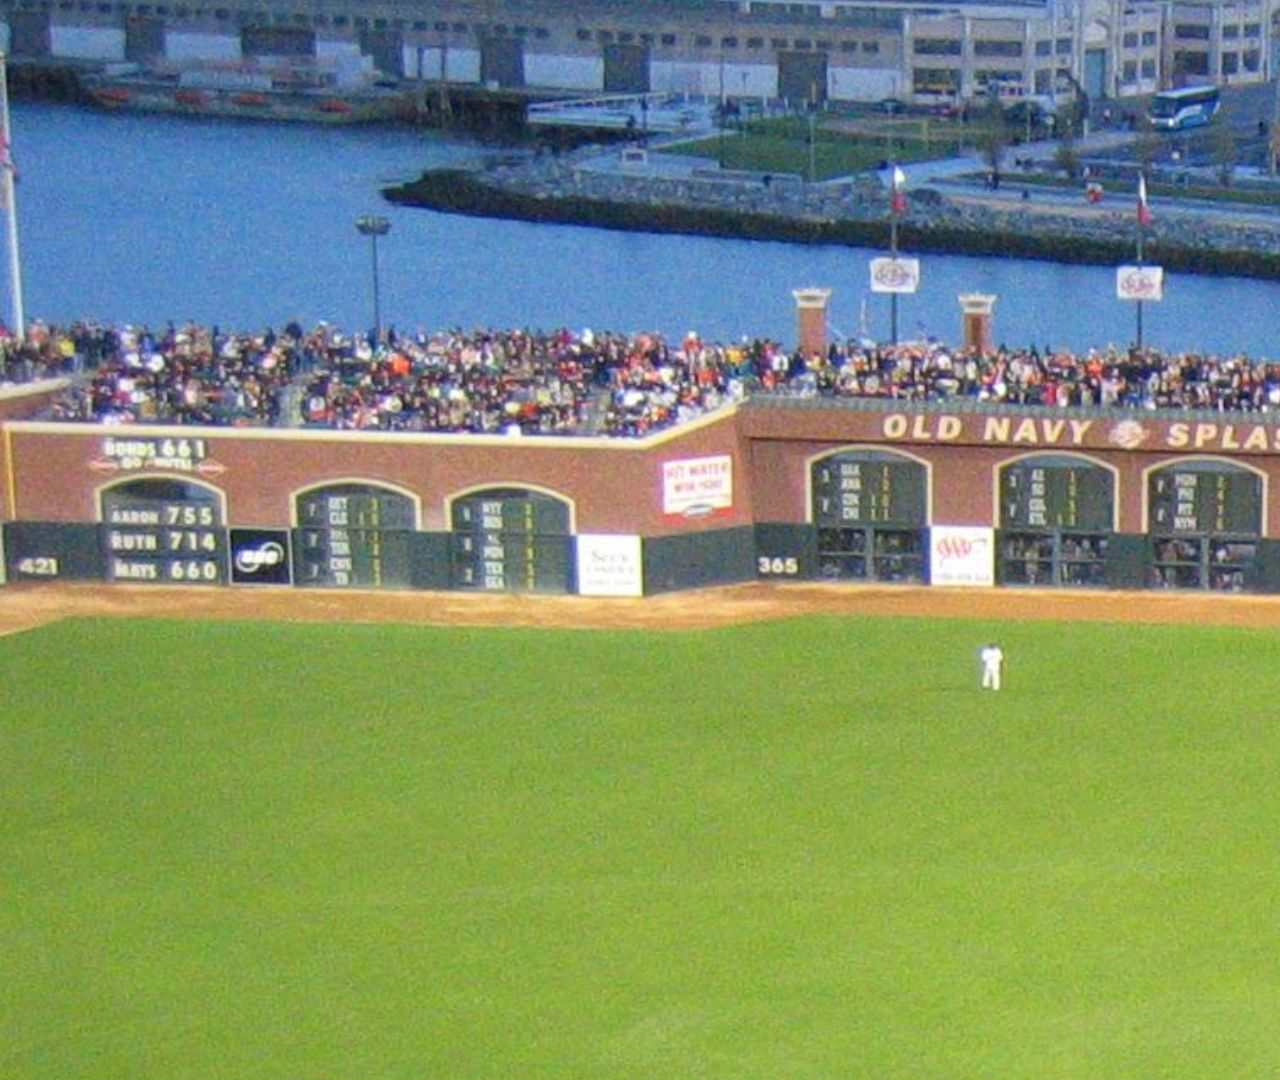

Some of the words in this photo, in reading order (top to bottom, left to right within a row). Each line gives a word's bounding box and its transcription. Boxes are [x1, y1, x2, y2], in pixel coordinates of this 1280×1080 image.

[883, 414, 962, 440] OLD
[983, 417, 1094, 446] NAVY
[105, 439, 157, 458] BONDS
[162, 438, 205, 459] 661
[111, 511, 160, 525] AARON
[167, 506, 213, 526] 755
[111, 531, 158, 551] RUTH
[170, 531, 217, 552] 714
[19, 557, 58, 575] 421
[114, 559, 157, 579] MAYS
[171, 561, 217, 580] 660
[758, 556, 798, 574] 365
